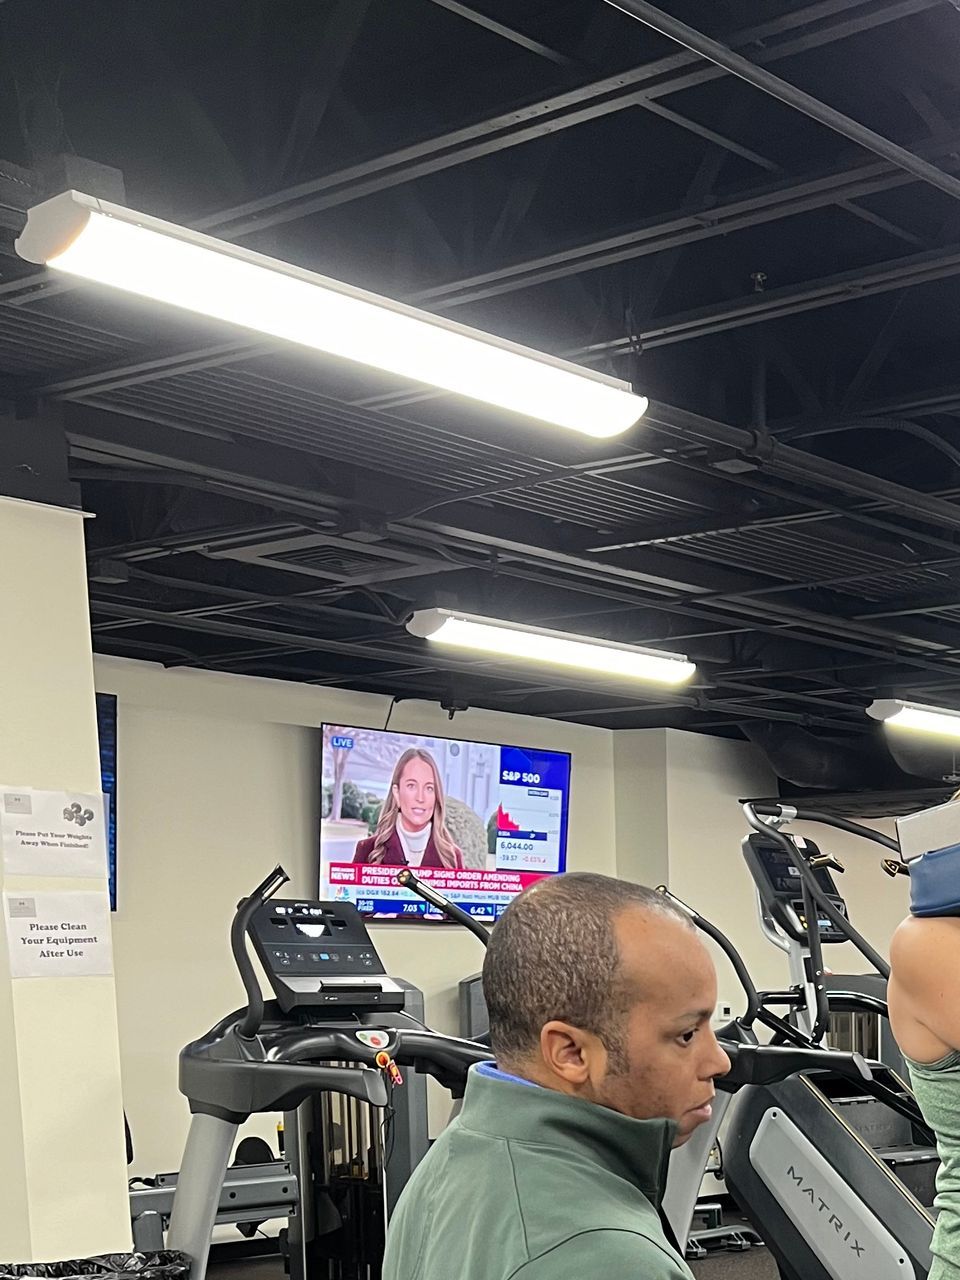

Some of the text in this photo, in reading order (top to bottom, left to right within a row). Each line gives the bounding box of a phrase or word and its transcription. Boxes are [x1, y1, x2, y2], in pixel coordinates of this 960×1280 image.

[333, 737, 352, 747] LIVE
[502, 770, 540, 784] S&P 500
[501, 842, 533, 850] 6,044.00
[331, 873, 355, 881] NEWS
[362, 866, 401, 876] PRESIDEN
[433, 870, 455, 879] SIGNS
[456, 871, 482, 880] ORDER
[483, 873, 521, 882] AMENDING
[362, 876, 390, 885] DUTIES
[447, 880, 479, 889] IMPORTS
[480, 881, 500, 890] FROM
[501, 882, 524, 891] CHINA
[403, 904, 417, 912] 7.03
[470, 906, 485, 914] 6.42
[29, 923, 87, 931] Please Clean
[20, 936, 98, 945] Your Equipment
[39, 949, 84, 958] After Use
[786, 1165, 866, 1258] MATRIX
